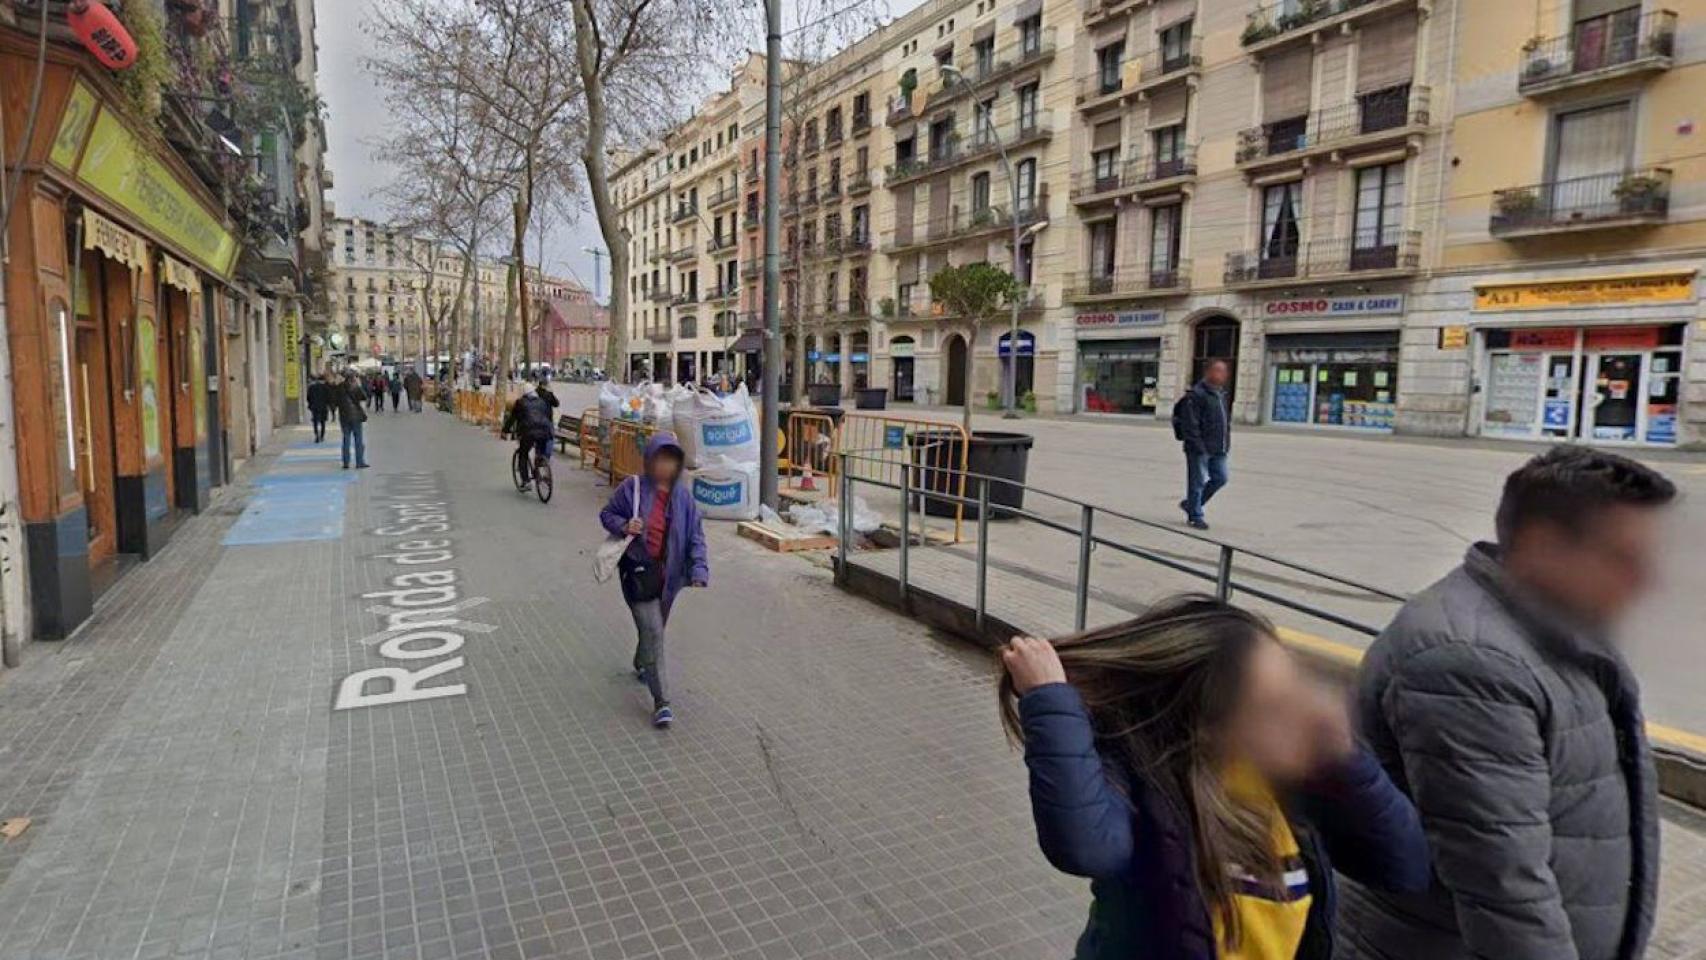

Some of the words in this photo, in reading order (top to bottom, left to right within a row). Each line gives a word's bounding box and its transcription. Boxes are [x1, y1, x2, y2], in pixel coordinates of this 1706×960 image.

[1267, 300, 1328, 314] COSMO
[1331, 301, 1355, 312] CASH
[1357, 300, 1364, 311] &
[1366, 298, 1400, 311] CARRY
[1076, 312, 1116, 325] COSMO
